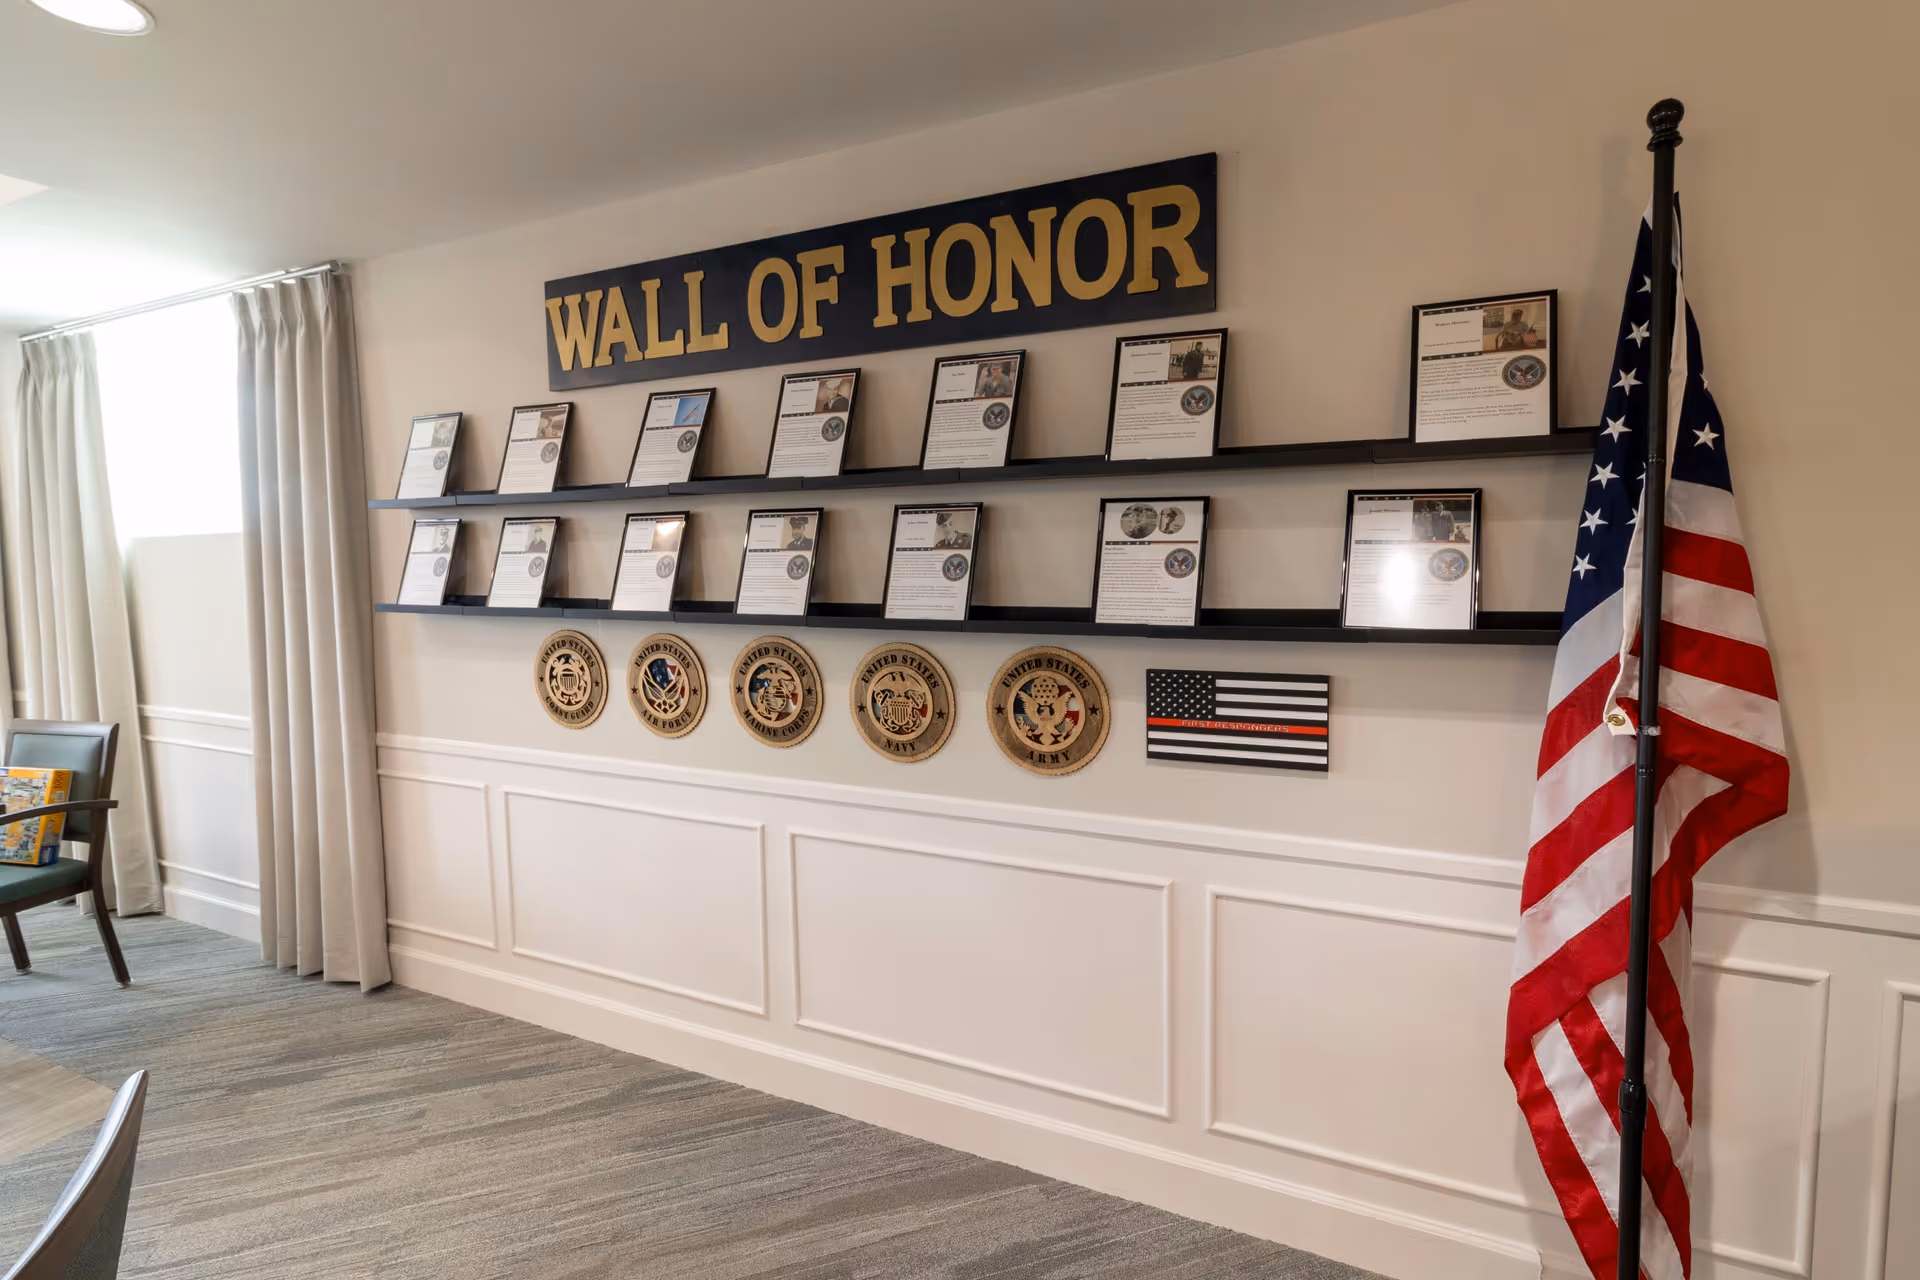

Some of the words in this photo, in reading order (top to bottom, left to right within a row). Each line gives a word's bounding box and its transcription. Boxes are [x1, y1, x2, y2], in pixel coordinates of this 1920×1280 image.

[546, 270, 729, 372] WALL
[747, 244, 845, 344] OF
[871, 184, 1209, 328] HONOR
[541, 639, 567, 664] UNITED
[568, 639, 596, 668] STATES
[634, 643, 661, 667] UNITED
[662, 643, 692, 669] STATES
[739, 646, 770, 676] UNITED
[773, 646, 808, 677] STATES
[861, 654, 898, 684] UNITED
[901, 655, 940, 689] STATES
[1002, 658, 1042, 688] UNITED
[1046, 658, 1090, 689] STATES
[545, 695, 569, 719] COAST
[570, 700, 595, 720] GUARD
[641, 709, 659, 728] AIR
[662, 709, 692, 729] FORCE
[744, 708, 777, 737] MARINE
[782, 708, 810, 736] CORPS
[1181, 719, 1212, 729] FIRST
[1214, 721, 1290, 733] RESPONDERS
[885, 738, 916, 752] NAVY
[1026, 750, 1070, 764] ARMY
